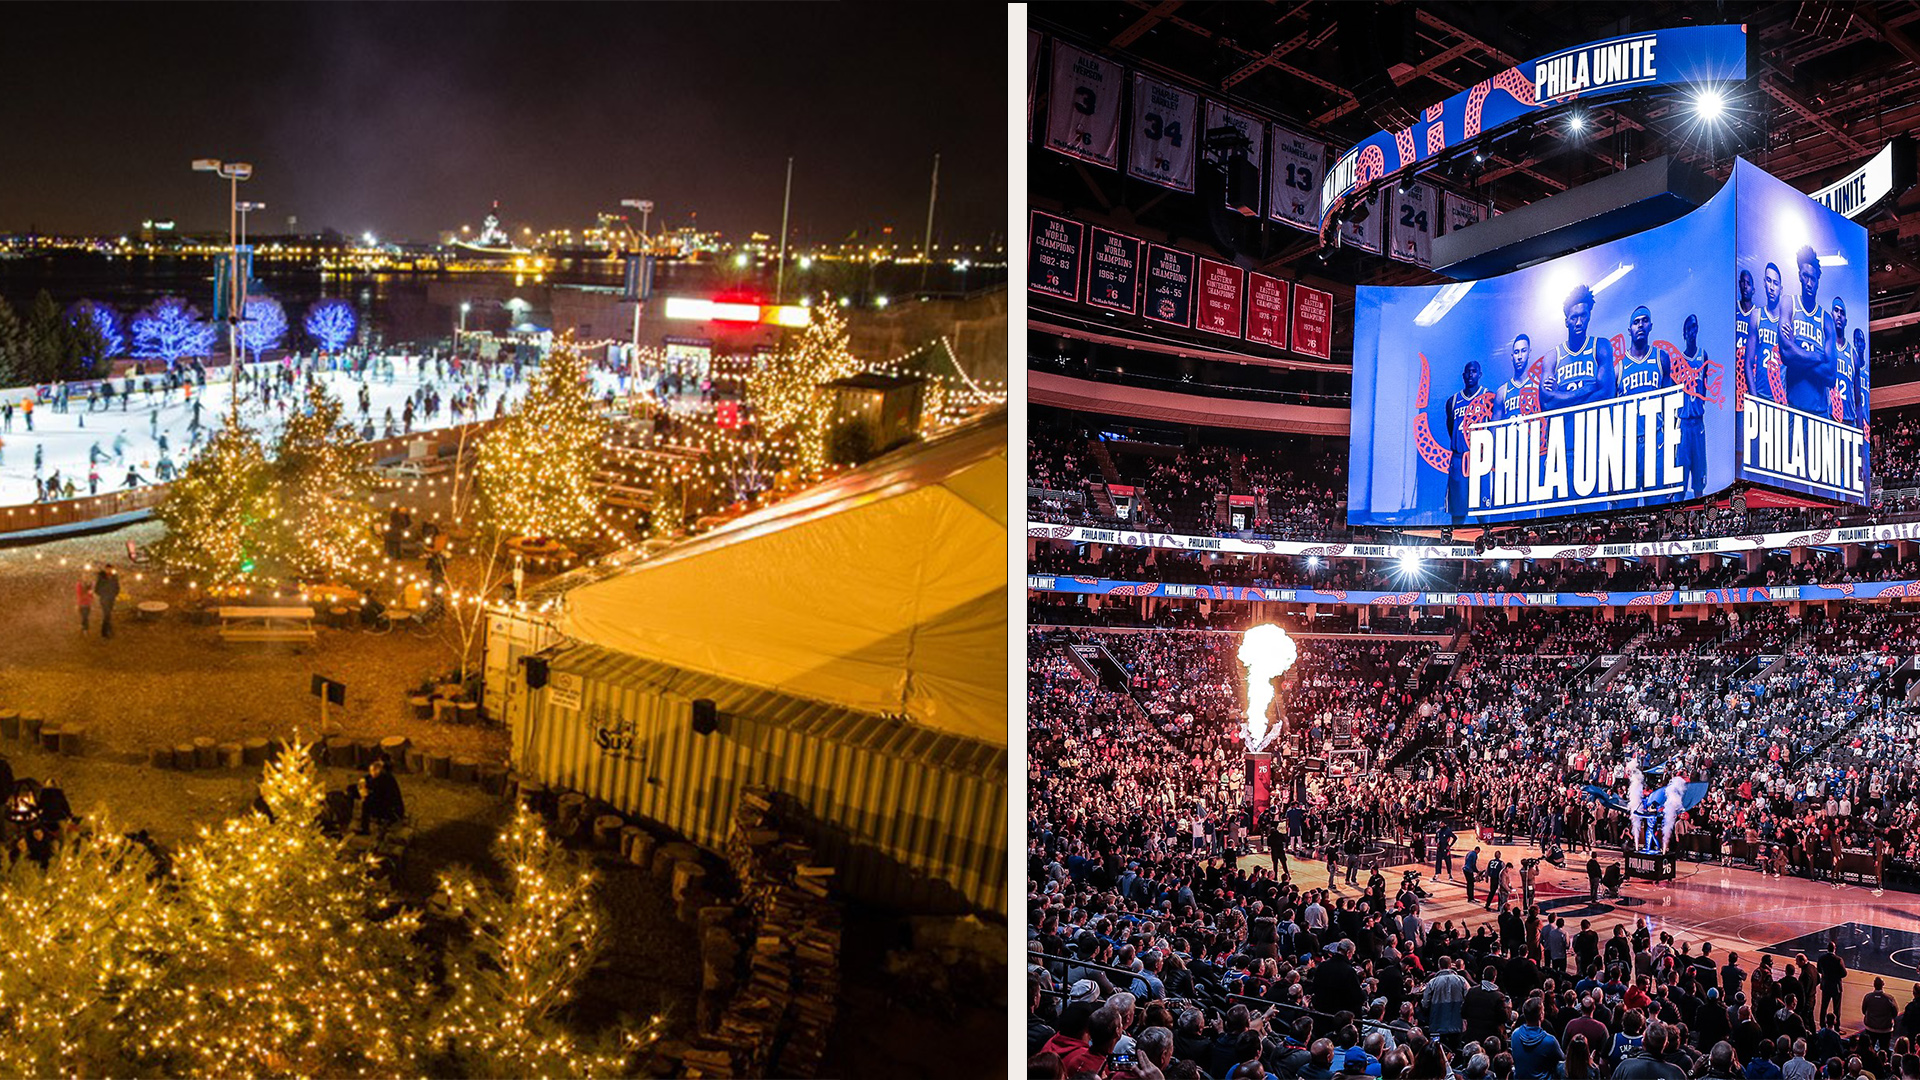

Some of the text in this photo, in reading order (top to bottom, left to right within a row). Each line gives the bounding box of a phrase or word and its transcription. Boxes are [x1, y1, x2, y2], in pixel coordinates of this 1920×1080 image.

[1078, 56, 1099, 71] ALLEN
[1535, 38, 1657, 101] PHILA UNITE
[1075, 86, 1096, 116] 3
[1144, 112, 1182, 148] 34
[1286, 163, 1312, 191] 13
[1834, 172, 1866, 214] UNITE
[1400, 204, 1428, 232] 24
[1050, 220, 1064, 233] NBA
[1045, 228, 1068, 244] WORLD
[1108, 236, 1122, 248] NBA
[1036, 236, 1075, 254] CHAMPIONS
[1104, 244, 1126, 258] WORLD
[1096, 252, 1132, 269] CHAMPIONS
[1164, 252, 1177, 264] NBA
[1160, 260, 1180, 273] WORLD
[1216, 268, 1227, 276] NBA
[1098, 270, 1127, 284] 1966-67
[1152, 267, 1187, 284] CHAMPIONS
[1211, 274, 1232, 284] EASTERN
[1206, 280, 1236, 293] CONFERENCE
[1207, 287, 1234, 299] CHAMPIONS
[1794, 320, 1823, 347] PHILA
[1557, 360, 1594, 384] PHILA
[1622, 370, 1659, 394] PHILA
[1468, 393, 1684, 508] PHILA UNITE
[1744, 400, 1864, 492] PHILA UNITE
[1082, 529, 1114, 542] PHILA UNITE
[1838, 529, 1869, 540] PHILA UNITE
[1189, 538, 1220, 549] PHILA UNITE
[1353, 545, 1385, 556] PHILA UNITE
[1603, 545, 1631, 555] PHILA UNITE
[1692, 540, 1718, 551] PHILA UNITE
[1452, 548, 1466, 556] PHILA
[1490, 861, 1499, 869] 27
[1663, 863, 1671, 874] 76
